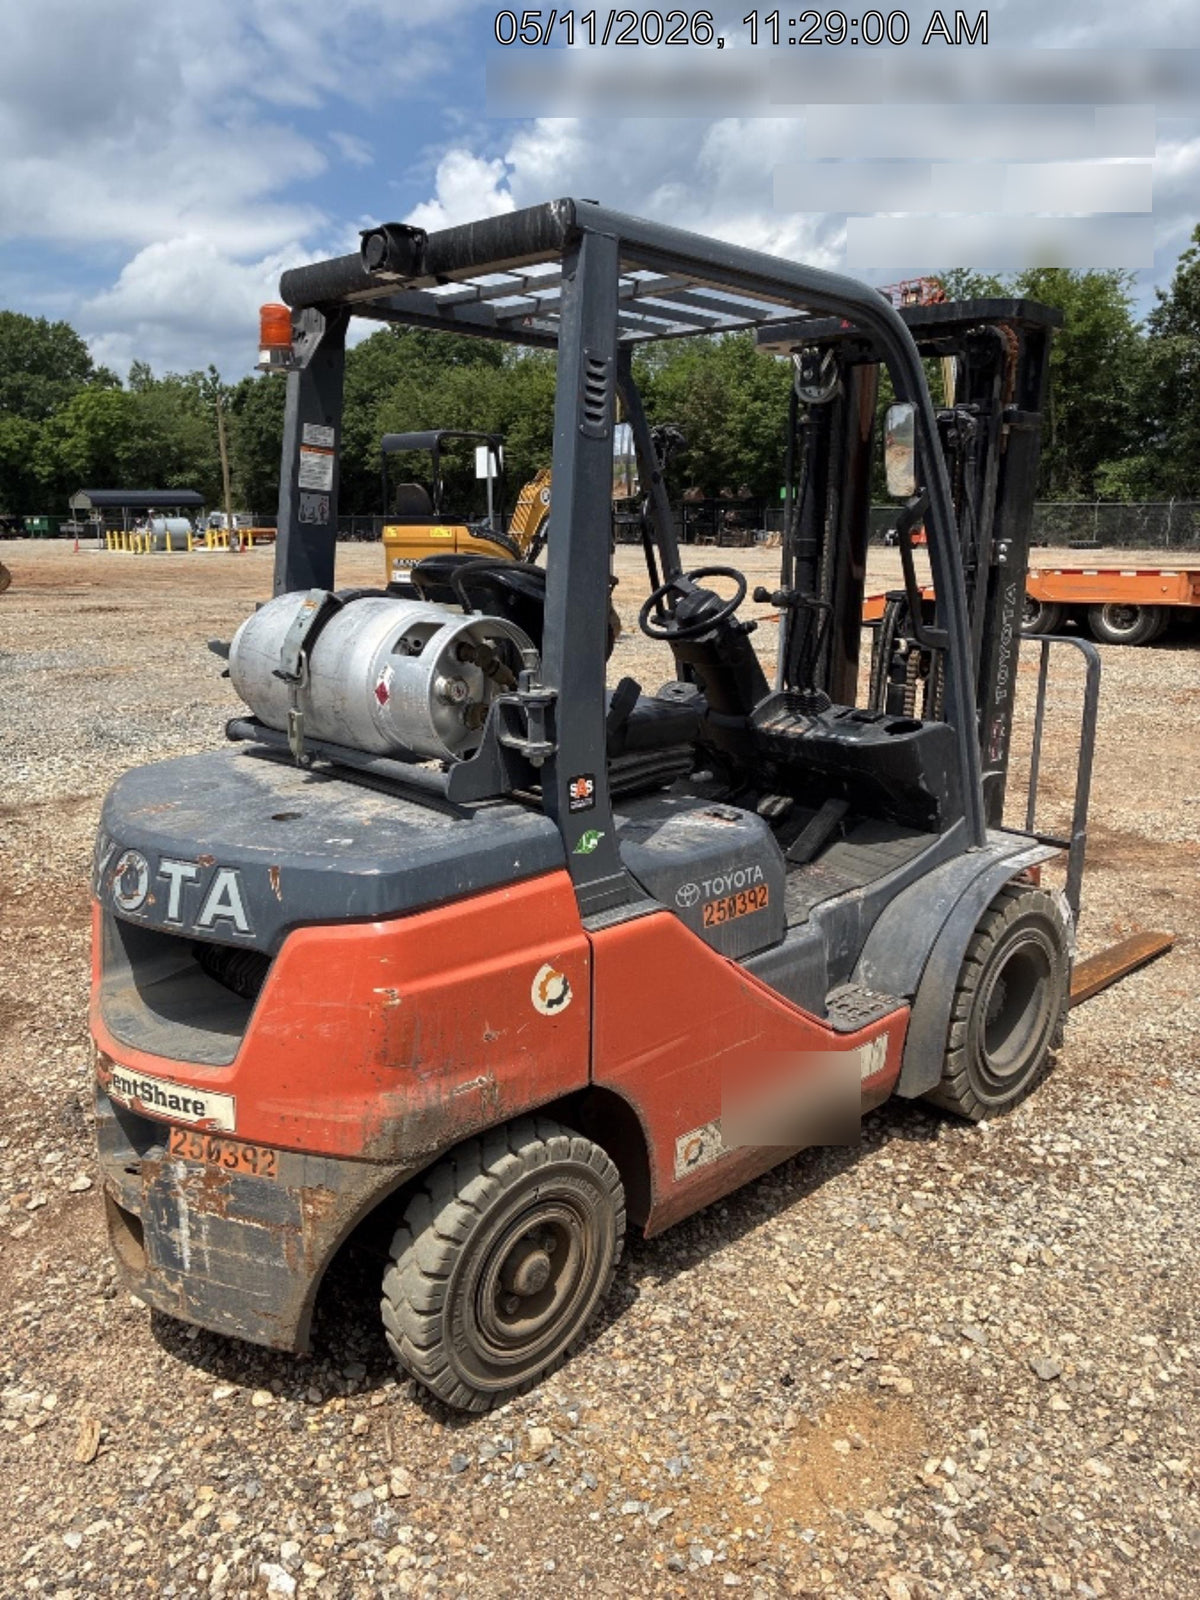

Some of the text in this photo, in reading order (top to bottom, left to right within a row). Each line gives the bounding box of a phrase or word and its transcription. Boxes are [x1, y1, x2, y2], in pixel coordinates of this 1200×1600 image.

[995, 582, 1017, 705] TOYOTA
[702, 865, 763, 897] TOYOTA
[704, 886, 767, 927] 250392
[109, 1071, 206, 1117] entShare
[171, 1129, 276, 1177] 250392
